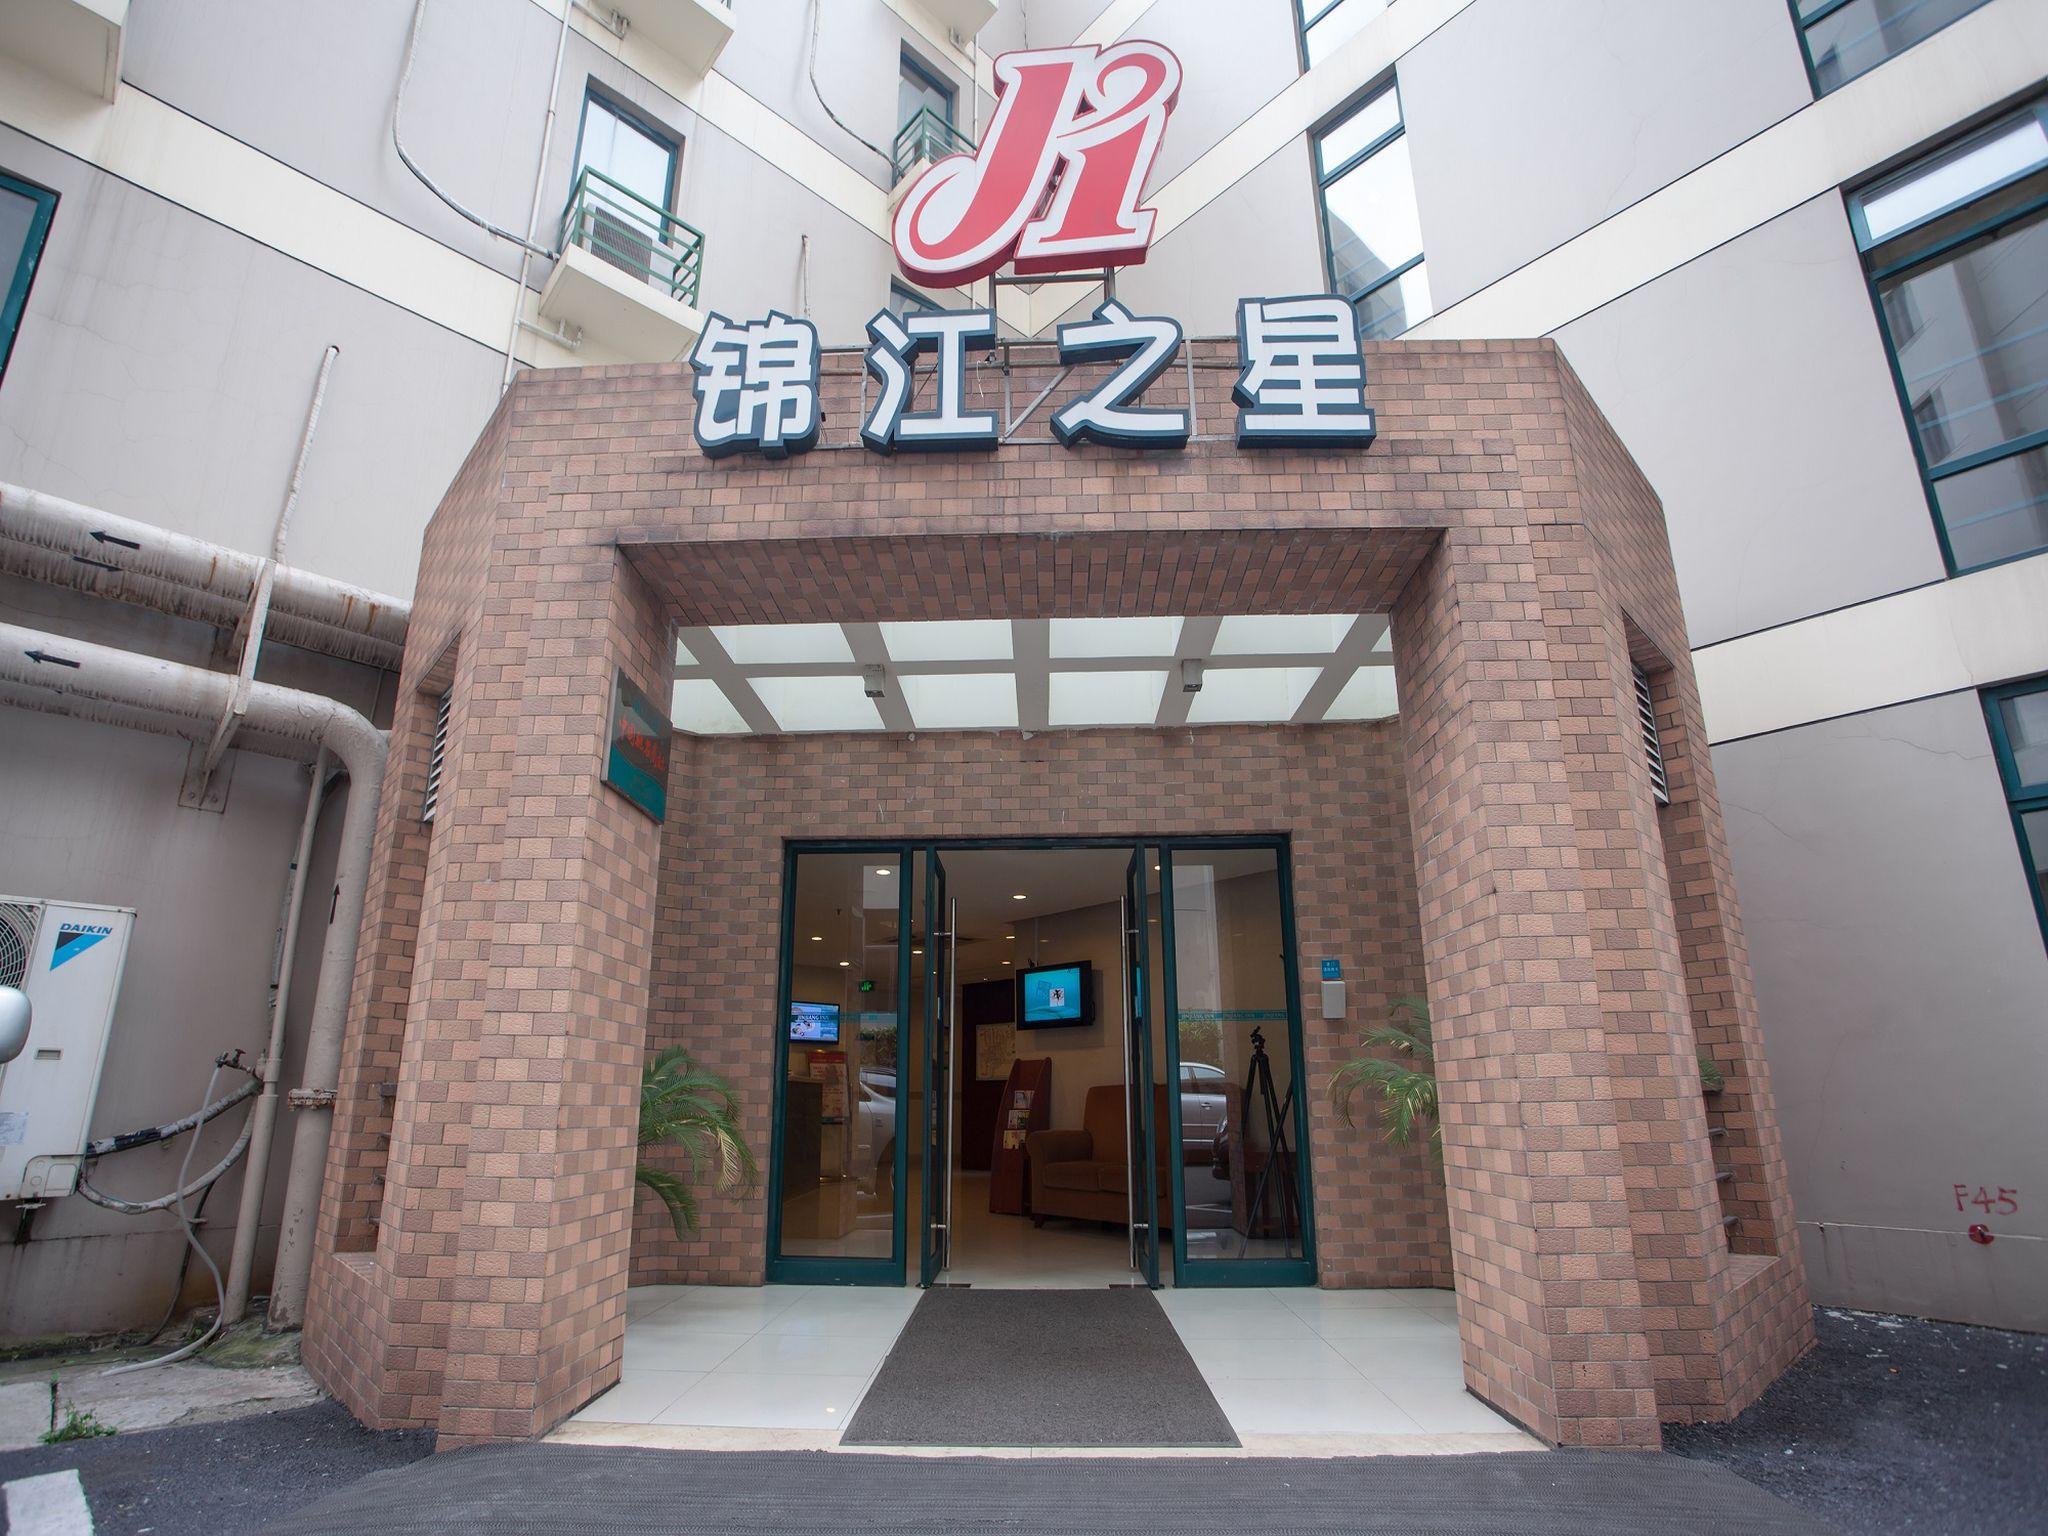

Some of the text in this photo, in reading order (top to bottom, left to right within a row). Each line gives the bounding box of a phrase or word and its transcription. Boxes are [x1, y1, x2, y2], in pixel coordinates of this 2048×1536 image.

[691, 296, 1376, 456] 锦江之星
[60, 923, 113, 934] DAIKIN
[1954, 1184, 2018, 1216] F45
